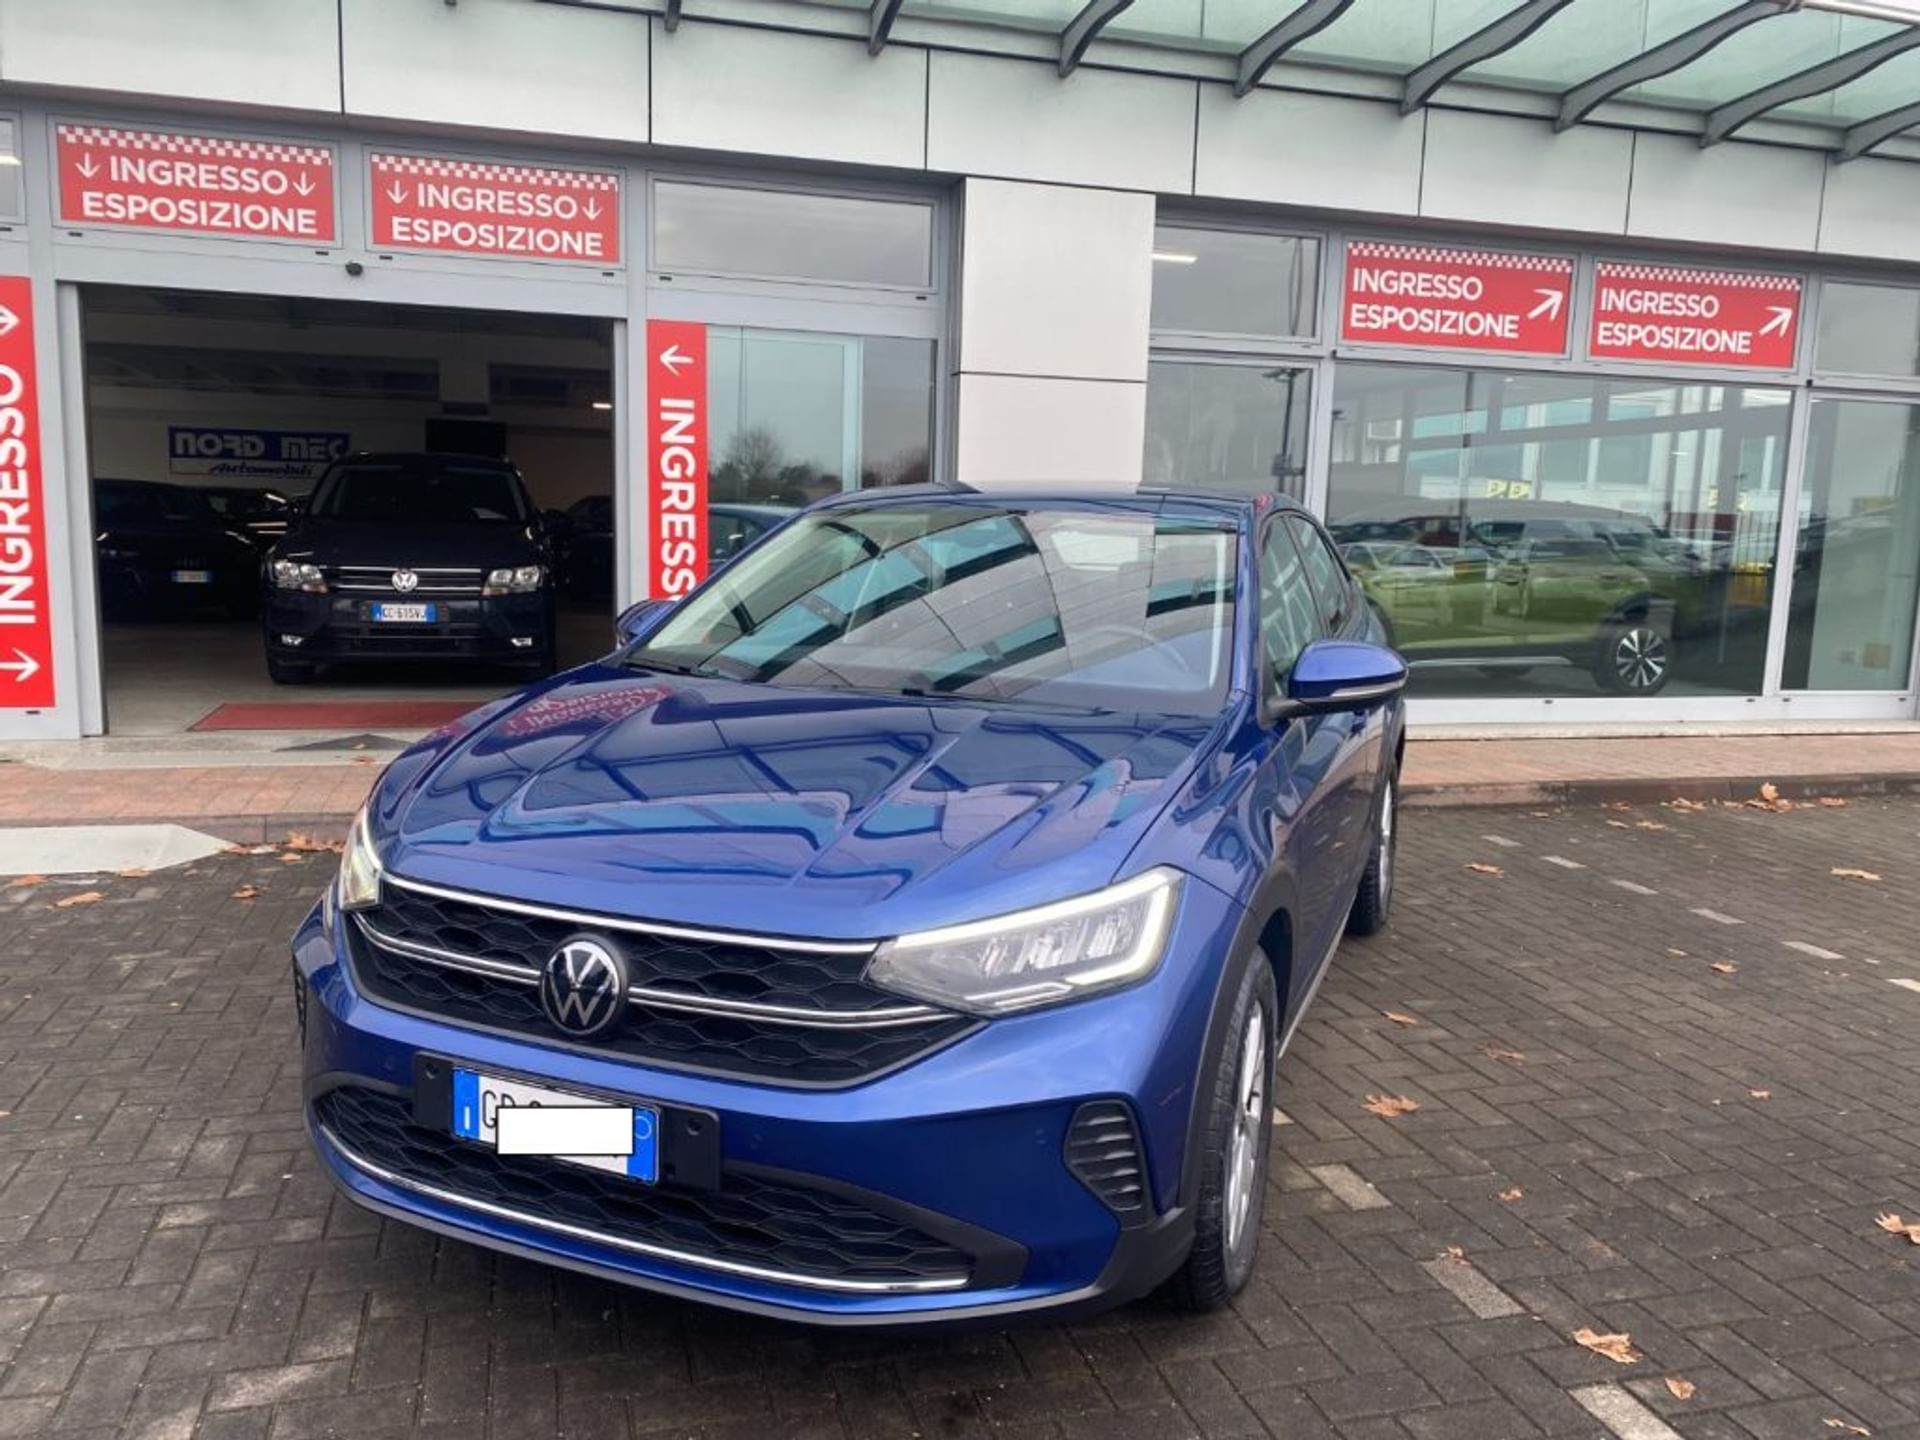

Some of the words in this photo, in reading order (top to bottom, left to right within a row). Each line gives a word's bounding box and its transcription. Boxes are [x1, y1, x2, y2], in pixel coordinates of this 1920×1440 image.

[111, 156, 288, 195] INGRESSO
[82, 191, 317, 234] ESPOSIZIONE
[417, 183, 578, 220] INGRESSO
[391, 216, 604, 257] ESPOSIZIONE
[1353, 267, 1483, 301] INGRESSO
[1350, 303, 1520, 338] ESPOSIZIONE
[1601, 288, 1719, 319] INGRESSO
[1597, 322, 1752, 354] ESPOSIZIONE
[174, 432, 265, 457] NORD
[660, 398, 696, 601] INGRESS
